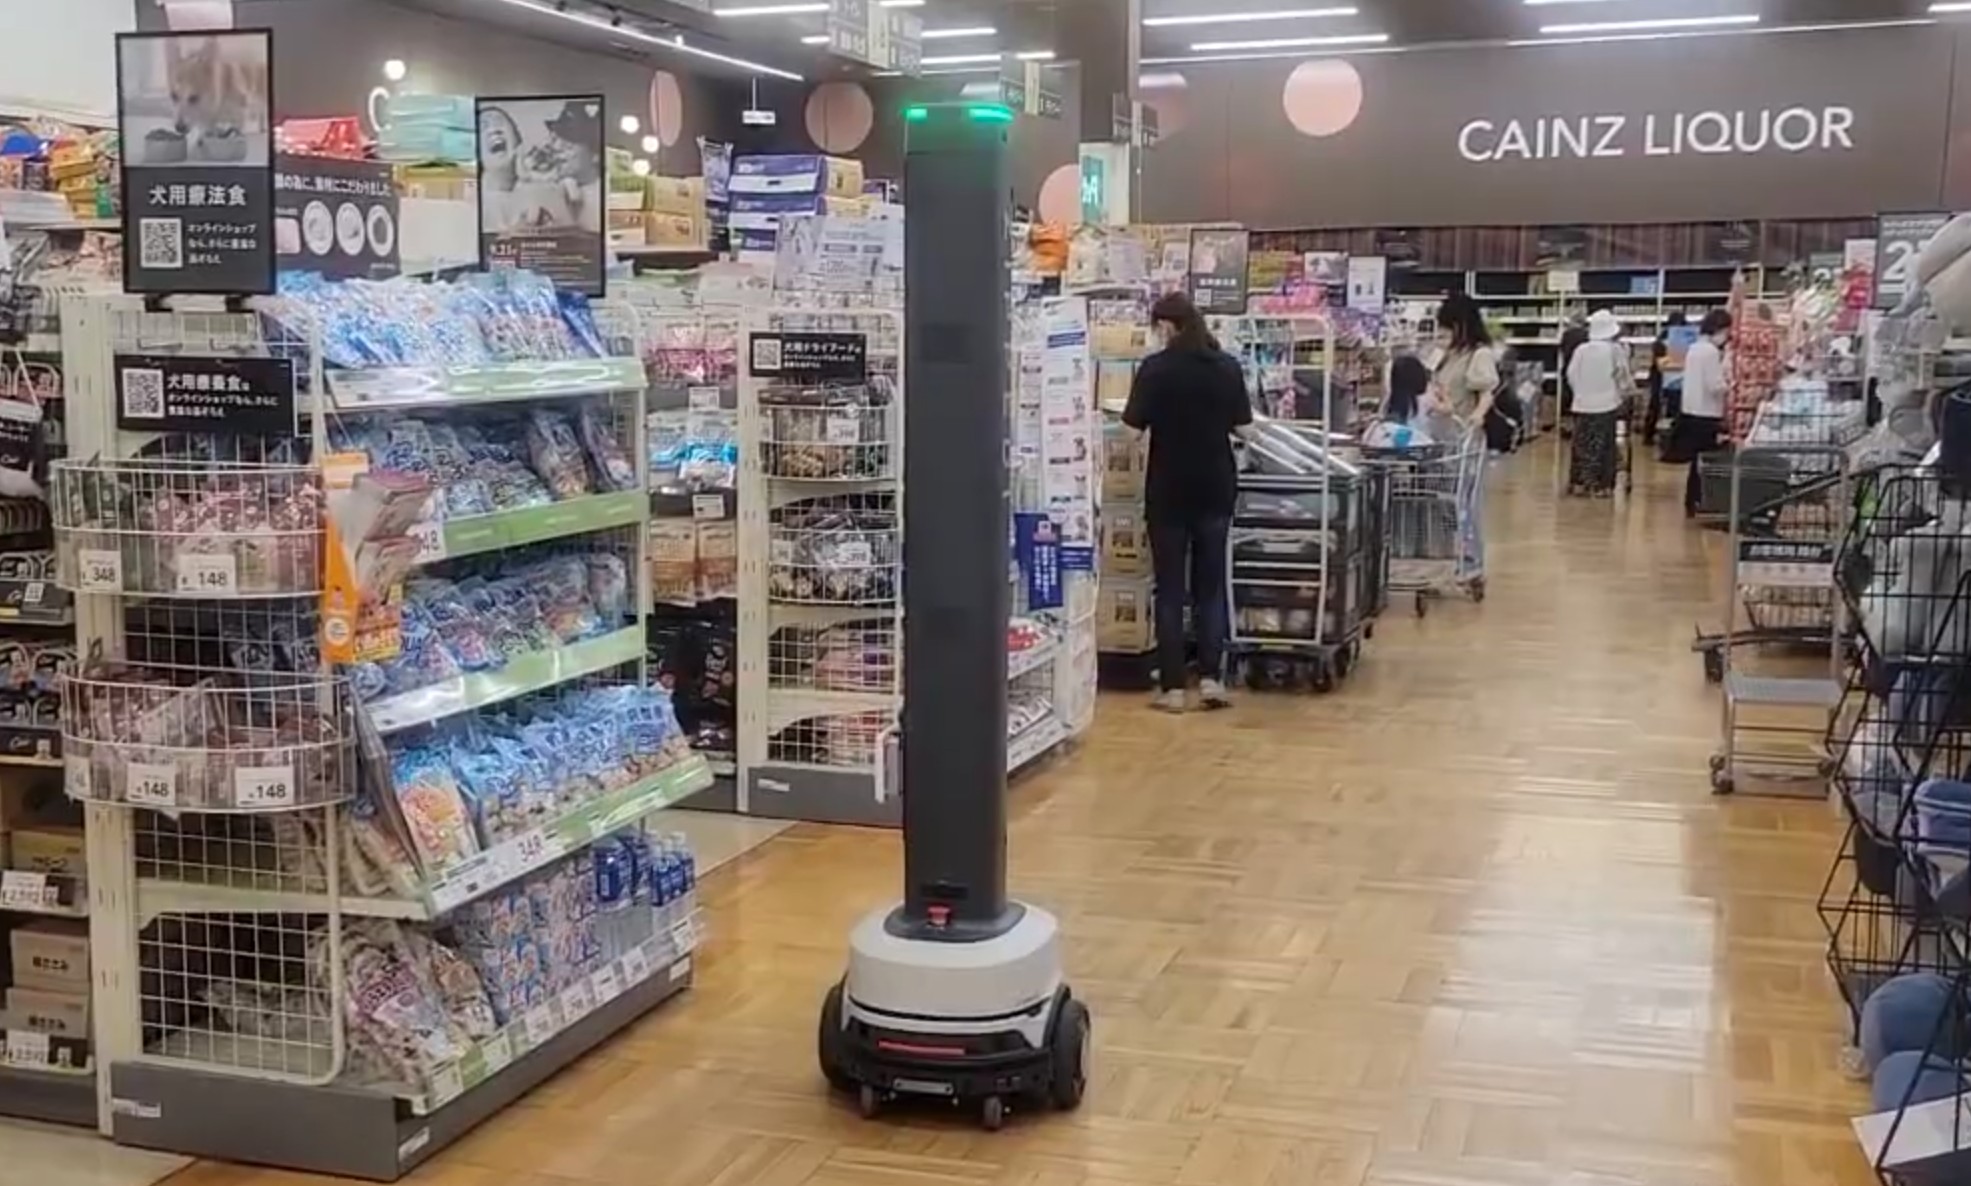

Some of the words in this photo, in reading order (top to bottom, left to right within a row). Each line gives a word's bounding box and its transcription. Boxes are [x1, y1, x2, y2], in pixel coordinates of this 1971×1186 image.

[1458, 115, 1626, 161] CAINZ
[1644, 106, 1853, 155] LIQUOR
[149, 184, 246, 206] 犬用療法食
[256, 785, 286, 799] 148
